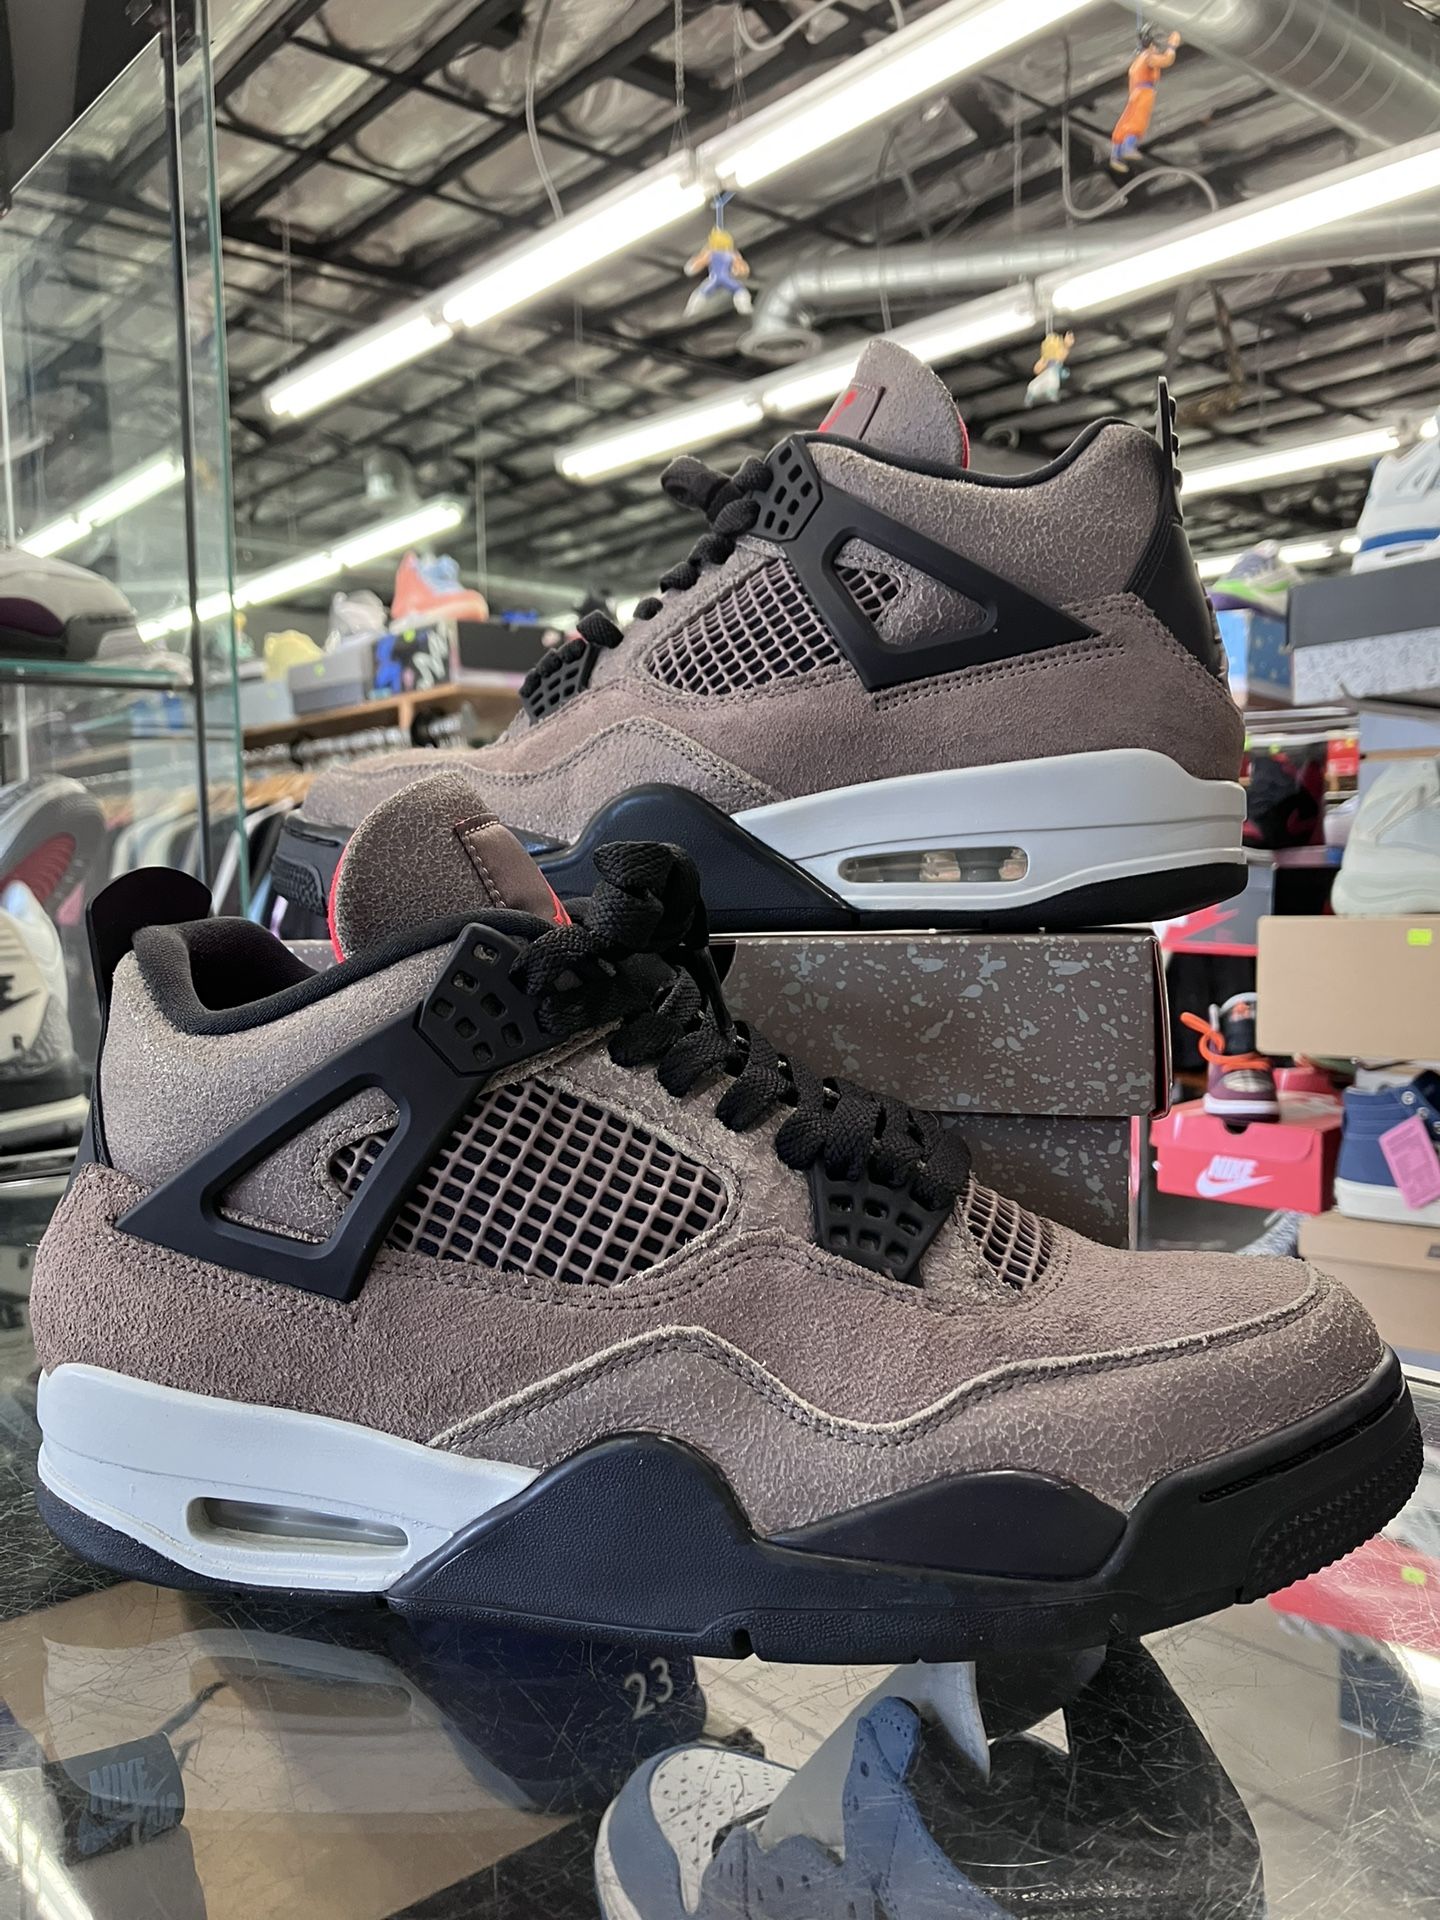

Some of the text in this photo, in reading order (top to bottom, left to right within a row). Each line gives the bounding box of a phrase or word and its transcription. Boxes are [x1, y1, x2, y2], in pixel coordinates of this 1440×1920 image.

[1208, 1154, 1259, 1181] NIKE
[624, 1656, 674, 1720] 23
[88, 1756, 149, 1817] NIKE
